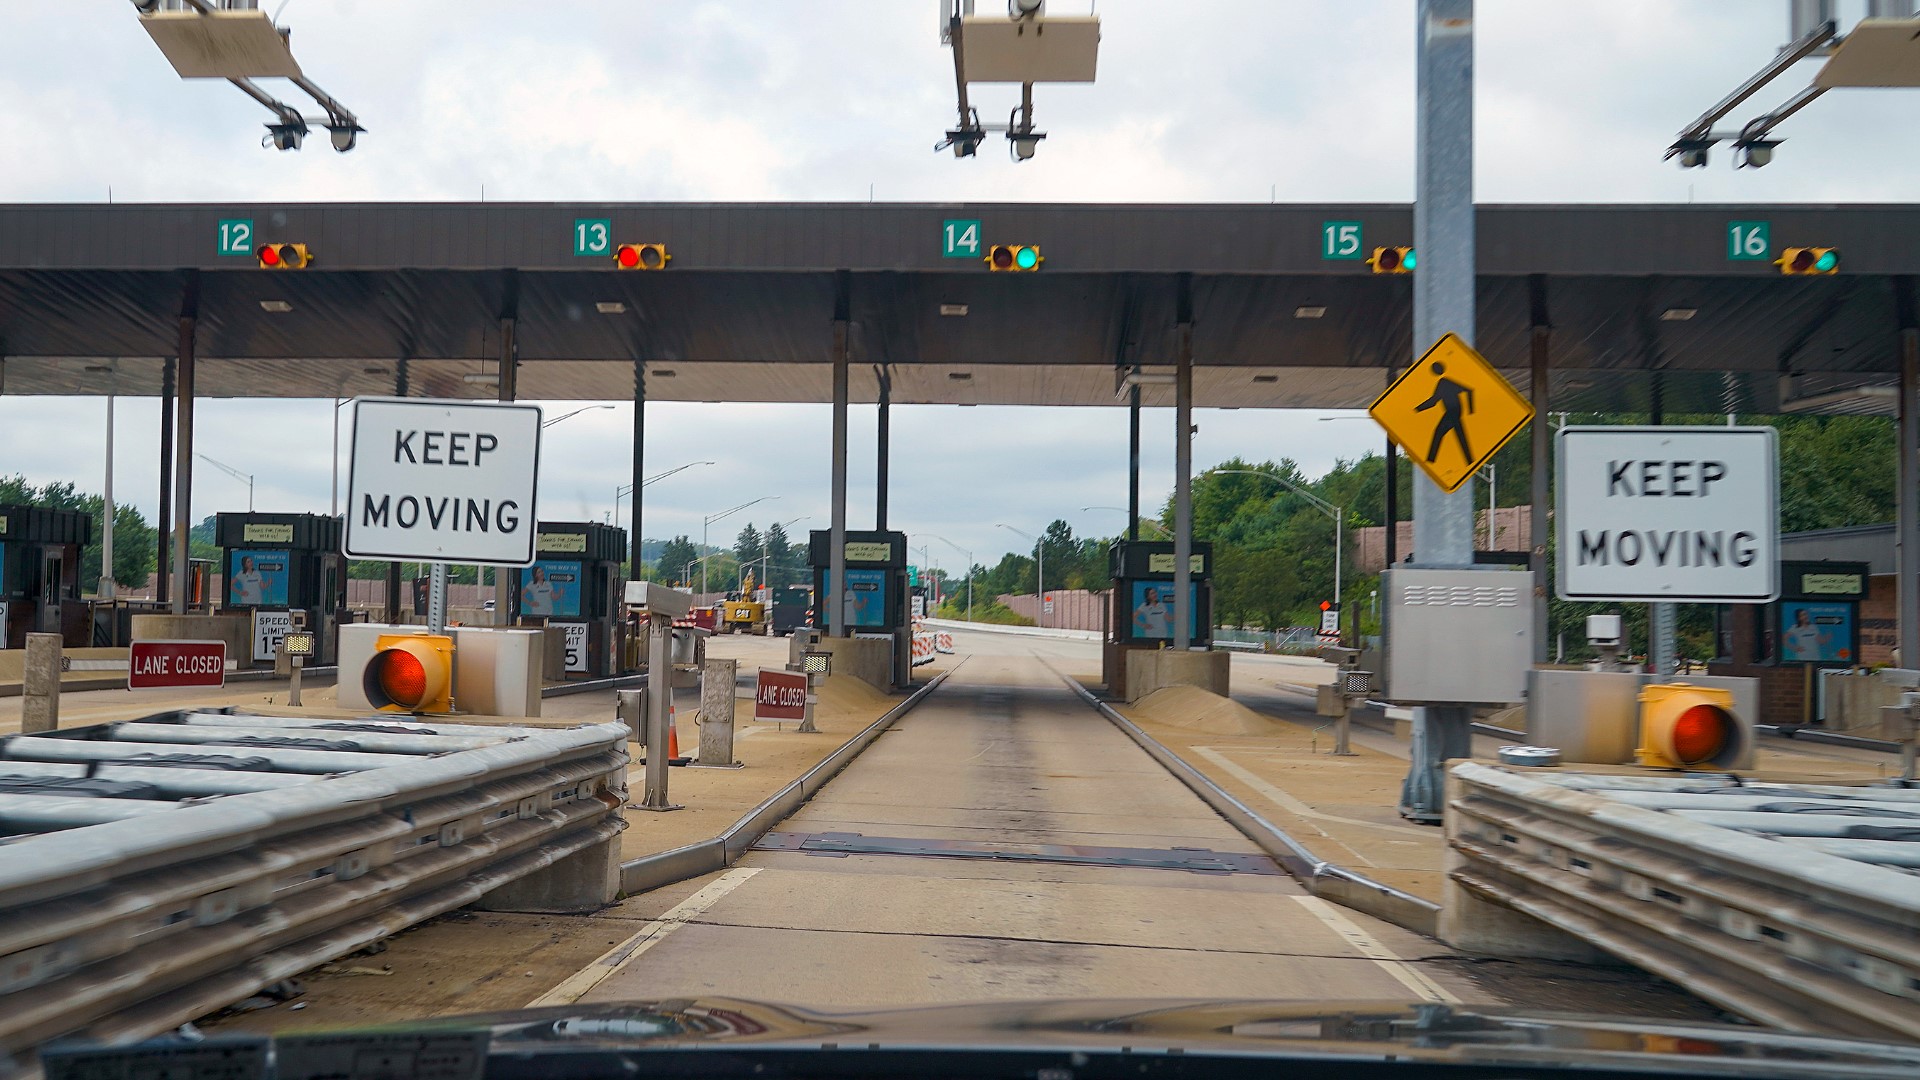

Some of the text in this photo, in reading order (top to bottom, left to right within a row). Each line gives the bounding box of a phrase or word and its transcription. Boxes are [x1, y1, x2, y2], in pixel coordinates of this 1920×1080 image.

[221, 223, 250, 251] 12
[578, 223, 607, 252] 13
[946, 223, 978, 253] 14
[1326, 225, 1359, 255] 15
[1731, 226, 1767, 256] 16
[394, 429, 498, 467] KEEP
[1606, 460, 1729, 498] KEEP
[362, 493, 519, 533] MOVING
[1577, 530, 1759, 568] MOVING
[259, 617, 289, 625] SPEED
[262, 627, 286, 635] LIMIT
[564, 626, 585, 635] EED
[134, 655, 221, 675] LANE CLOSED
[758, 684, 804, 707] LANE CLOSED
